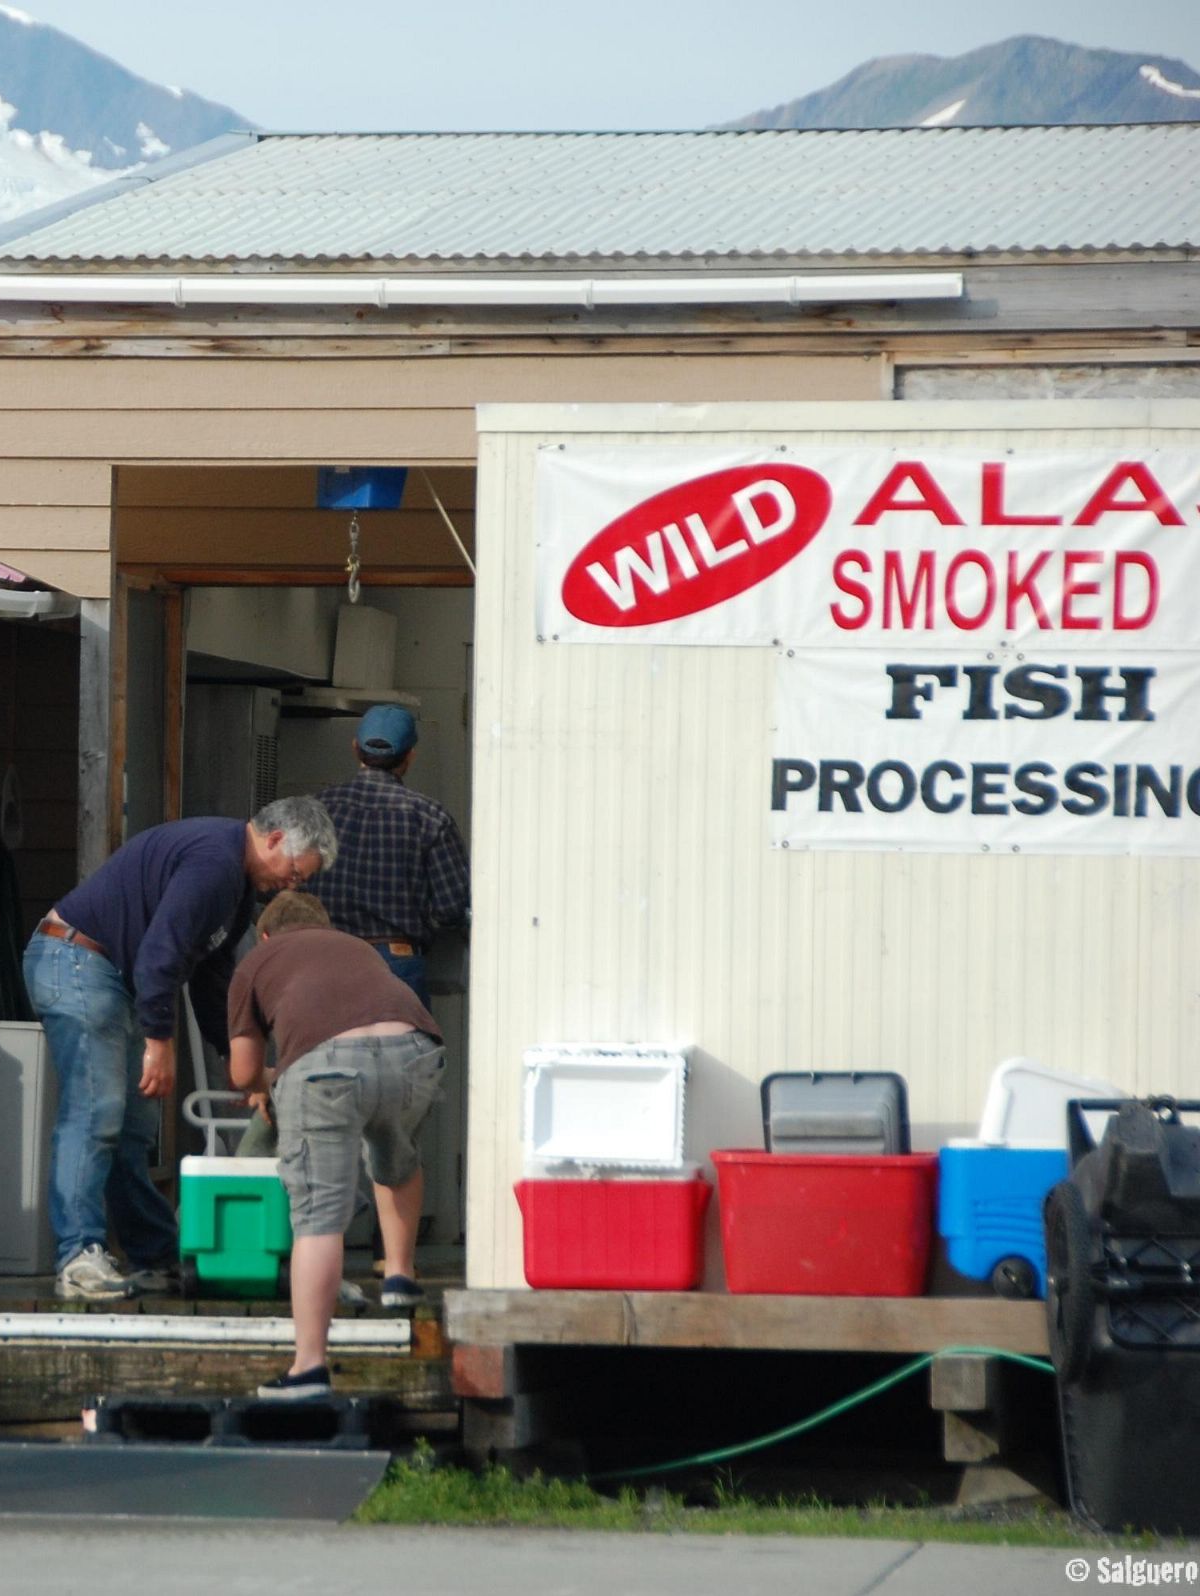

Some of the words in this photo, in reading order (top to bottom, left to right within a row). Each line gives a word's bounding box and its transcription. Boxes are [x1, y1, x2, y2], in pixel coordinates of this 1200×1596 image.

[852, 461, 1200, 526] ALA
[585, 478, 797, 613] WILD
[830, 548, 1161, 631] SMOKED
[884, 663, 1157, 721] FISH
